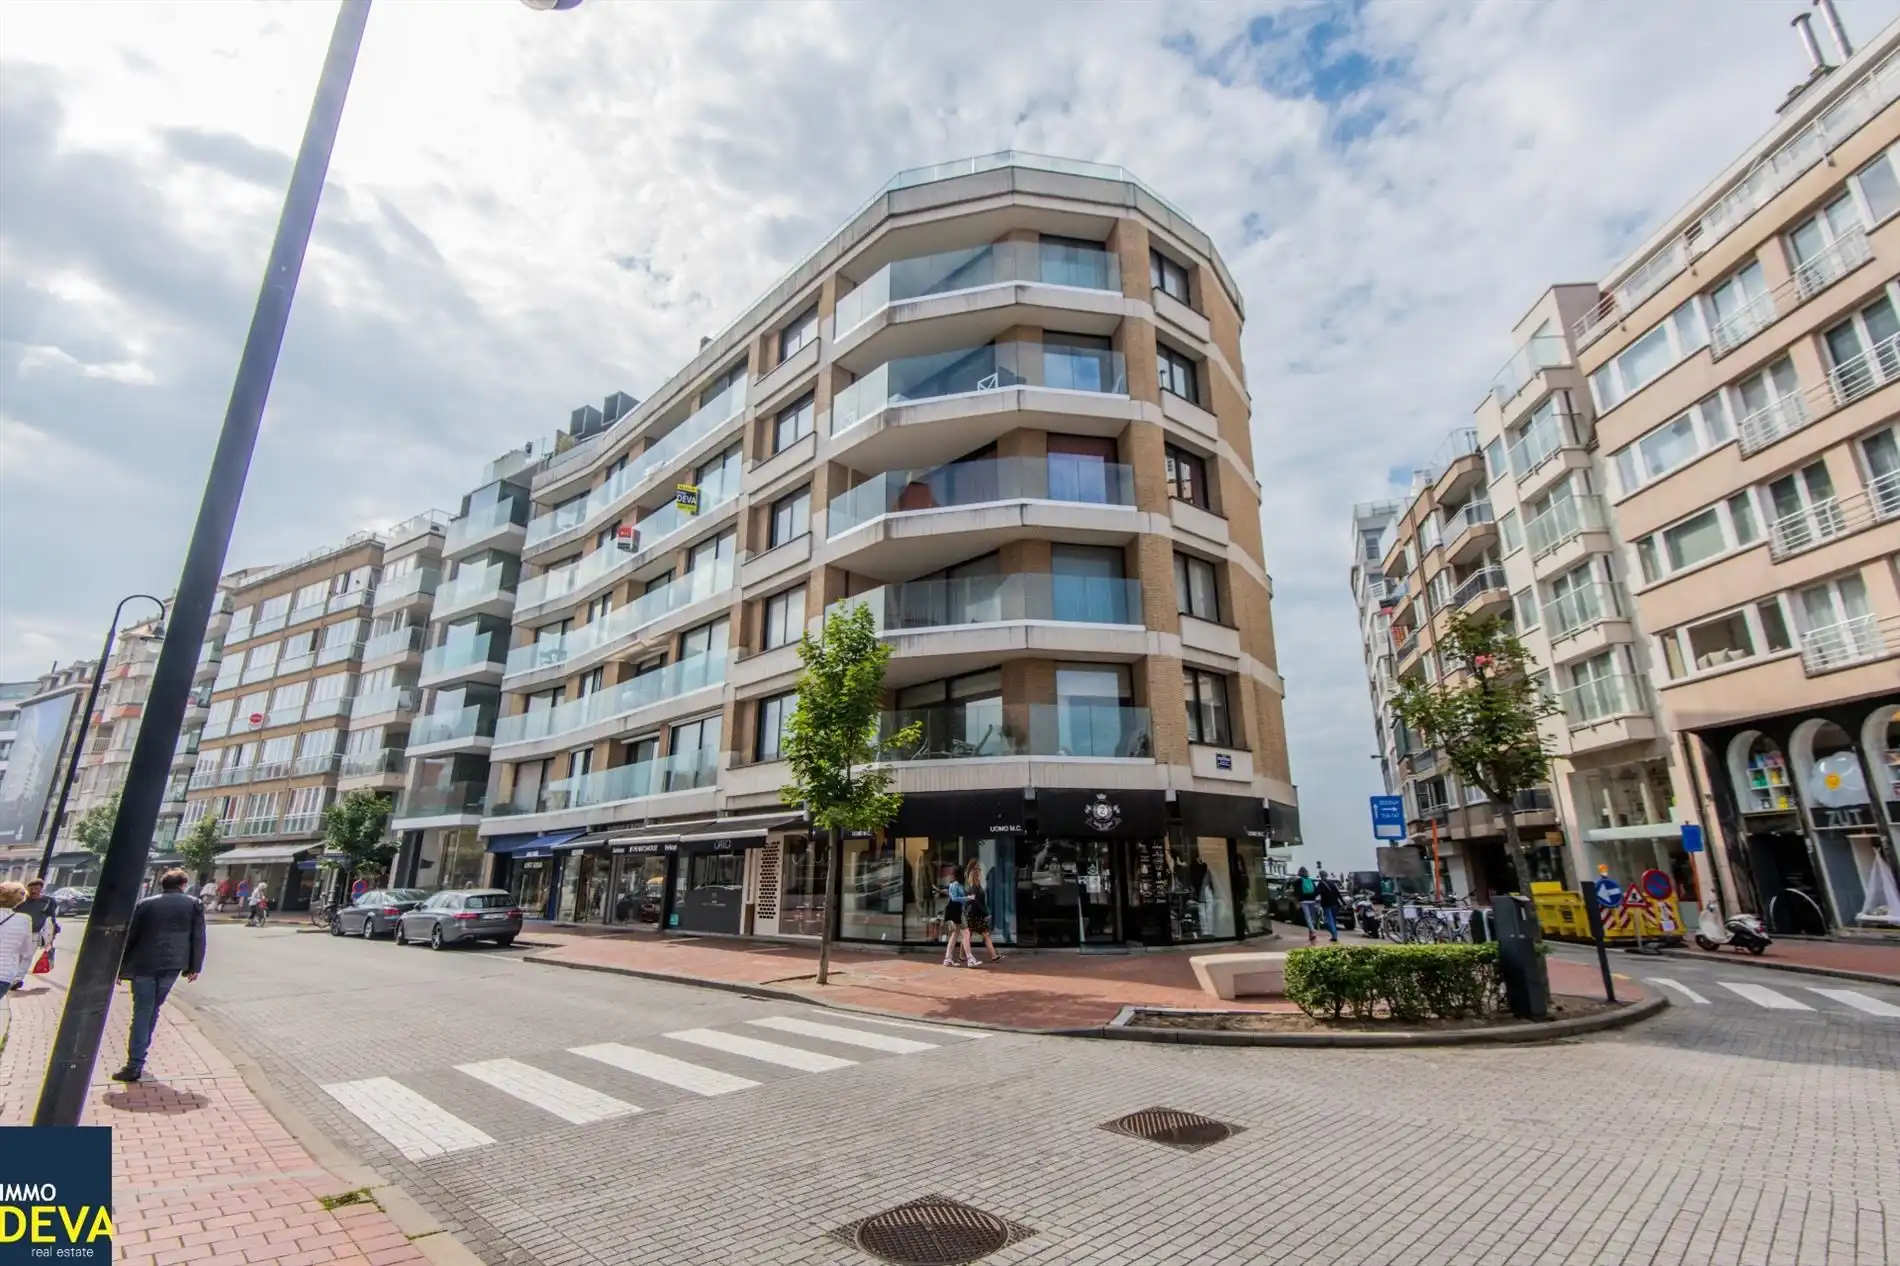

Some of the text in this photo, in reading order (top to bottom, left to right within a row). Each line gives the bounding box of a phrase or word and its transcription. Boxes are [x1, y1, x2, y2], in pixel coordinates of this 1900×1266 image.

[677, 494, 697, 505] DEVA
[1824, 808, 1863, 827] ZUT
[989, 825, 1009, 833] UOMO
